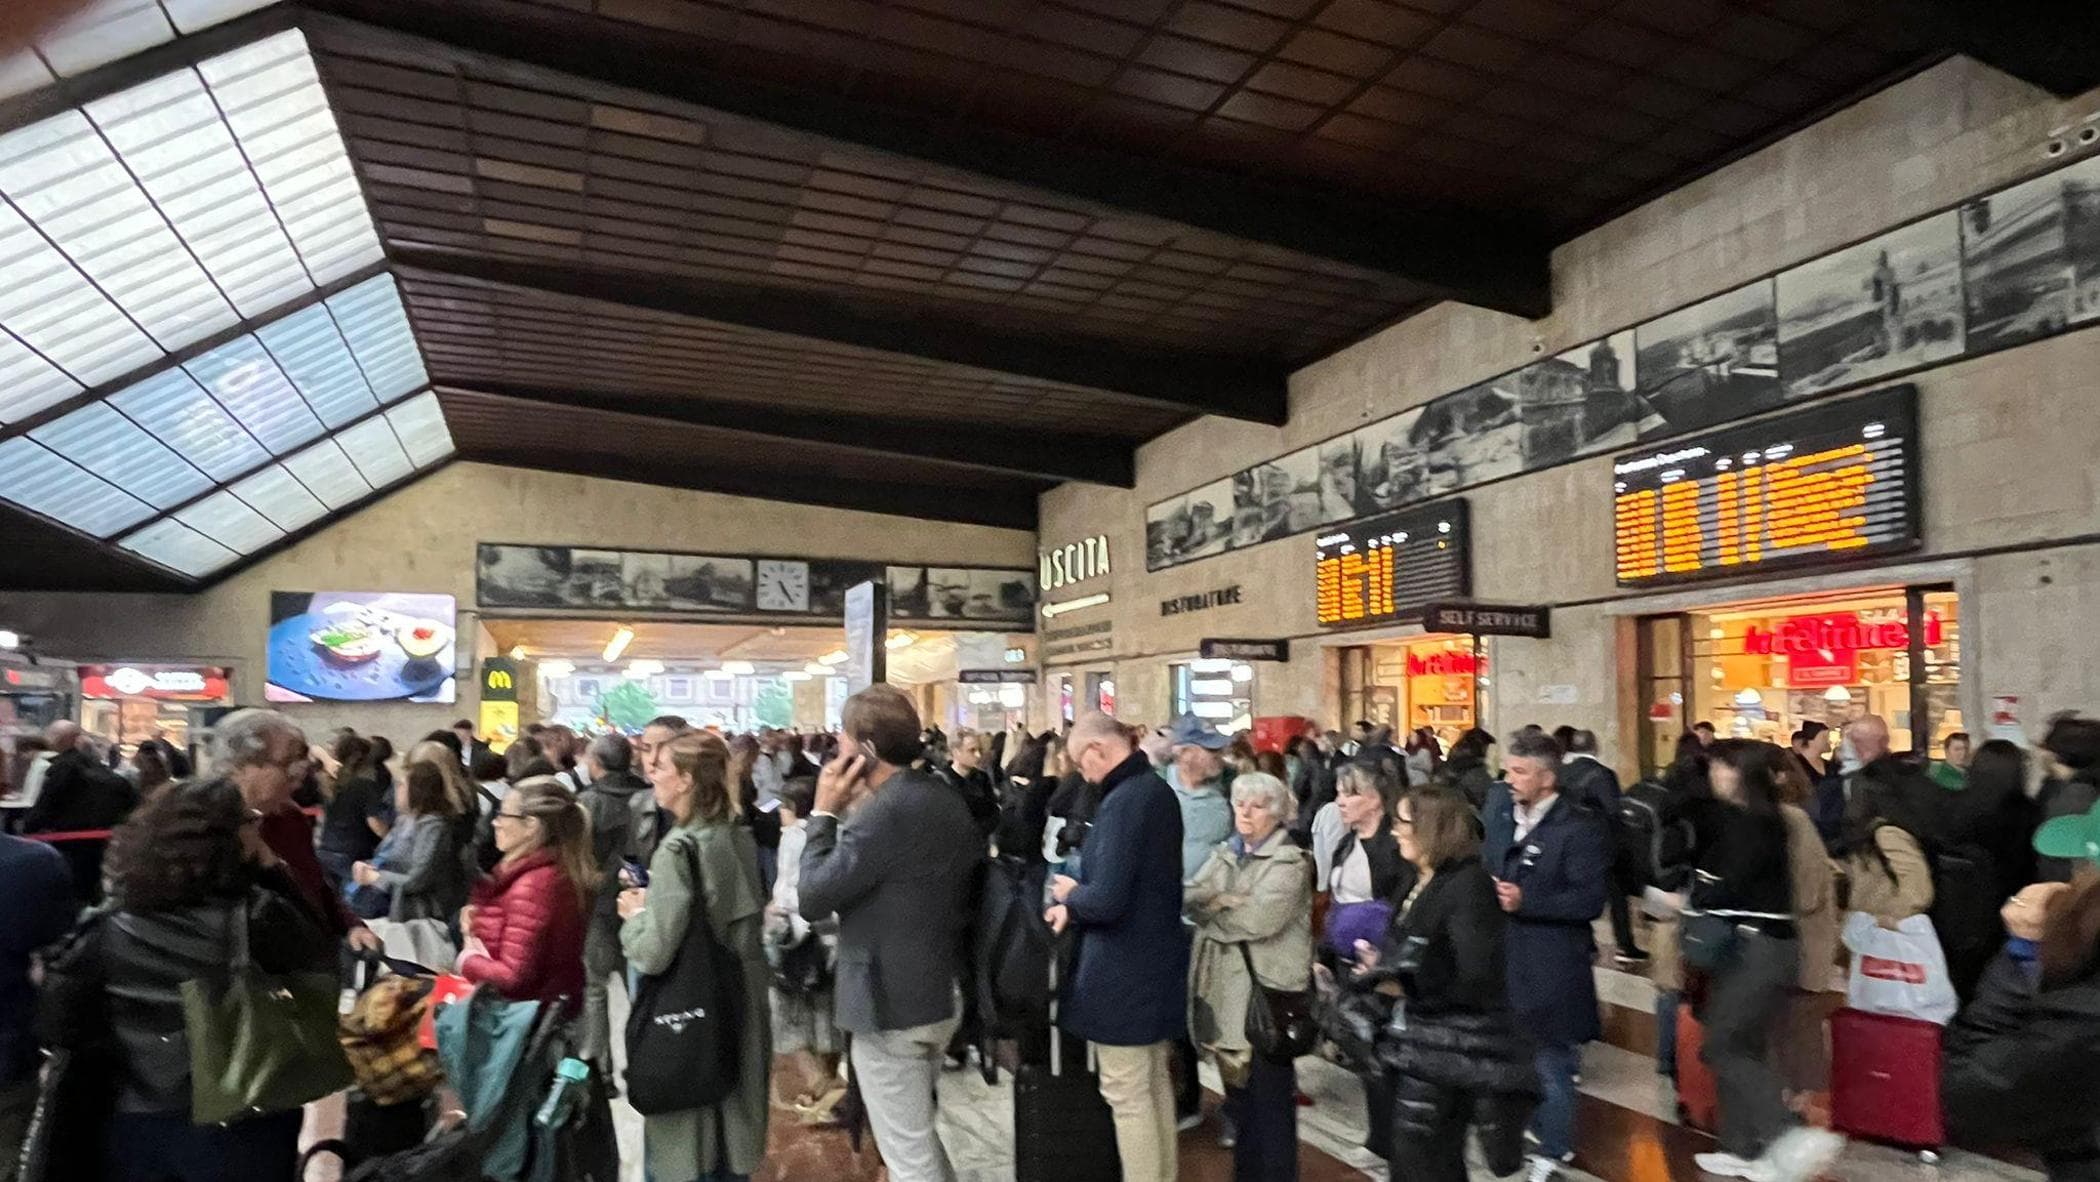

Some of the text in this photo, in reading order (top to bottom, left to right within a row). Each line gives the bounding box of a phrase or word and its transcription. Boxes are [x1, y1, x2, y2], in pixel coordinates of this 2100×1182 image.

[1040, 534, 1110, 591] USCITA
[1439, 610, 1538, 628] SELF SERVICE
